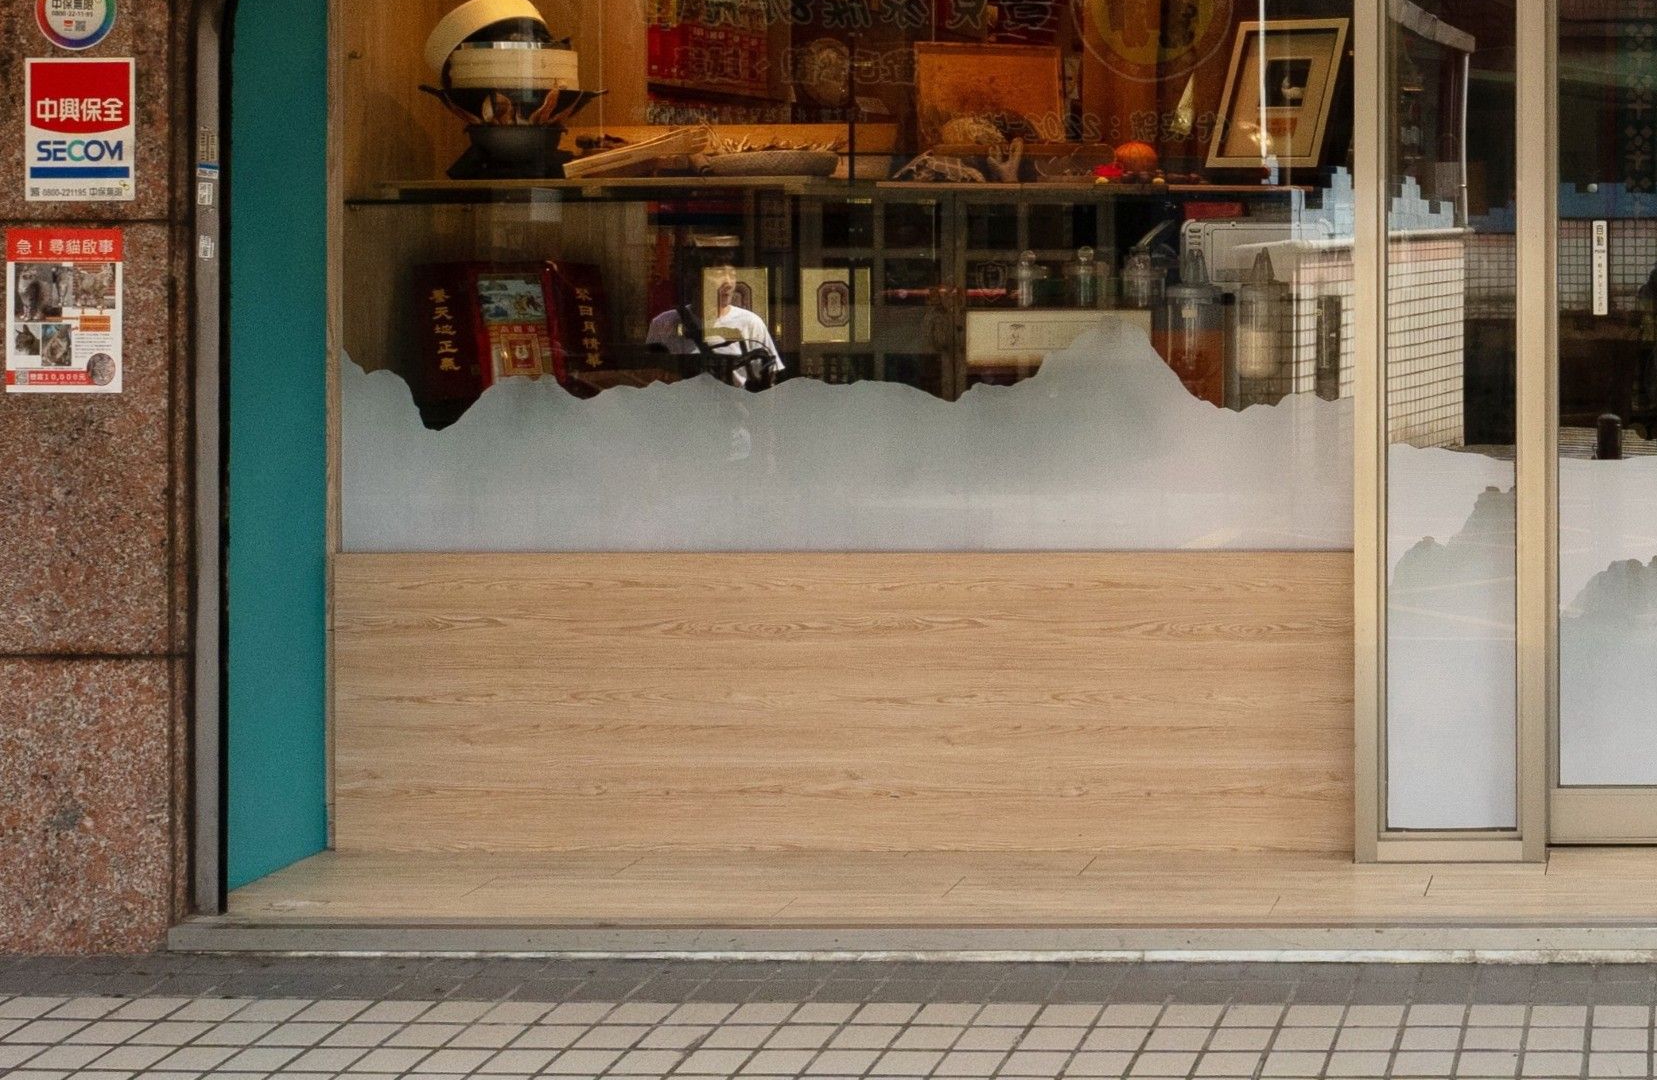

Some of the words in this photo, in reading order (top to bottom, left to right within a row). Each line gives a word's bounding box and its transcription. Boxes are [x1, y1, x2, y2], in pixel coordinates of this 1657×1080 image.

[36, 97, 124, 123] 中興保全
[36, 139, 123, 162] SECOM
